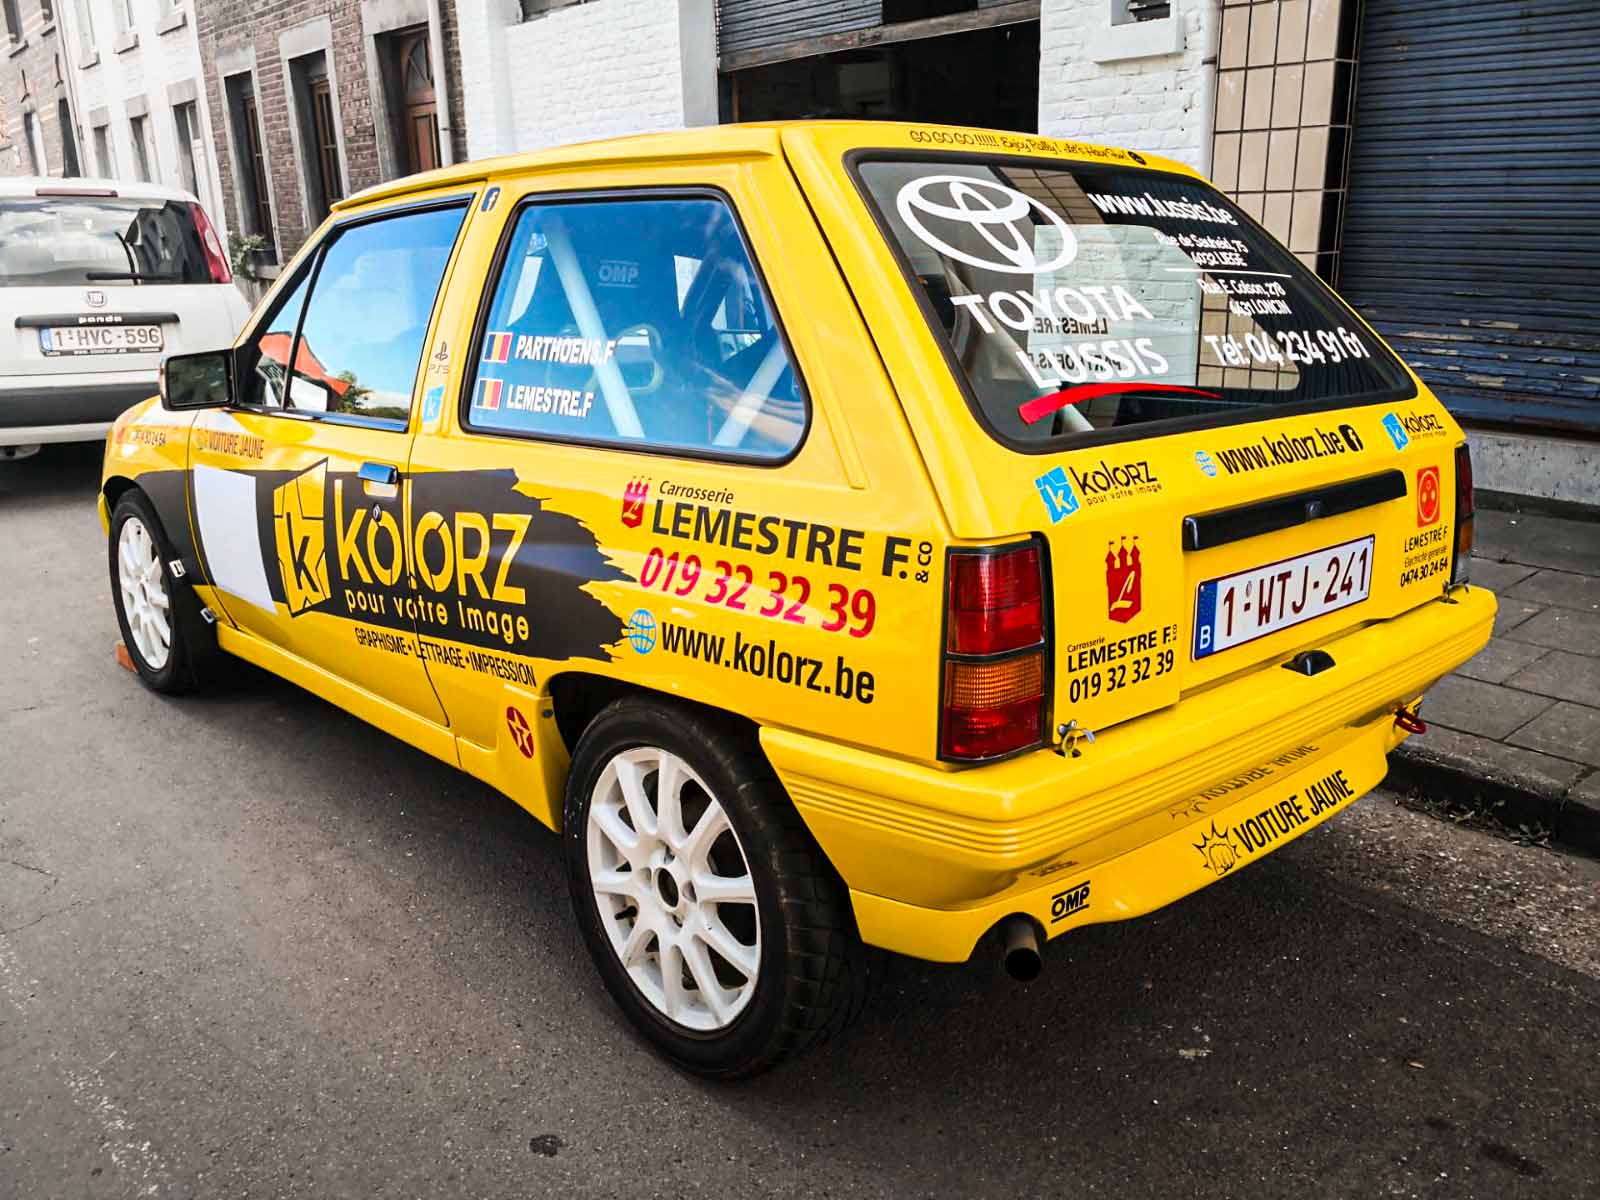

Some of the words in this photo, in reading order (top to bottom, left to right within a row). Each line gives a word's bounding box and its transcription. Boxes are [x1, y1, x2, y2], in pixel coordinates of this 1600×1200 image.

[1087, 192, 1239, 226] www.lussis.be
[950, 285, 1155, 334] TOYOTA
[1016, 338, 1169, 389] LUSSIS
[1245, 331, 1285, 367] 04
[1276, 330, 1327, 365] 234
[1316, 329, 1349, 363] 91
[1337, 326, 1371, 359] 61
[506, 383, 595, 417] LEMESTRE.F
[1215, 427, 1346, 475] www.kolorz.be
[659, 480, 735, 505] Carrosserie
[652, 498, 866, 572] LEMESTRE
[881, 535, 913, 580] F.
[1404, 527, 1443, 553] LEMESTRE
[639, 547, 702, 597] 019
[704, 560, 754, 611] 32
[759, 571, 811, 625] 32
[821, 583, 877, 639] 39
[1223, 547, 1369, 638] 1-WTJ-241
[1400, 568, 1419, 588] 0474
[345, 588, 386, 614] pour
[393, 591, 449, 625] votre
[354, 626, 409, 656] GRAPHISME
[411, 638, 467, 669] LETTRAGE
[468, 650, 537, 688] IMPRESSION
[1067, 637, 1106, 653] Carrosserie
[1067, 630, 1158, 674] LEMESTRE
[1199, 625, 1212, 650] B
[661, 620, 876, 705] www.kolorz.be
[1069, 672, 1102, 704] 019
[1107, 664, 1127, 693] 32
[1131, 656, 1151, 684] 32
[1156, 649, 1174, 677] 39
[1232, 794, 1310, 854] VOITURE
[1304, 769, 1355, 817] JAUNE
[1051, 886, 1091, 917] OMP
